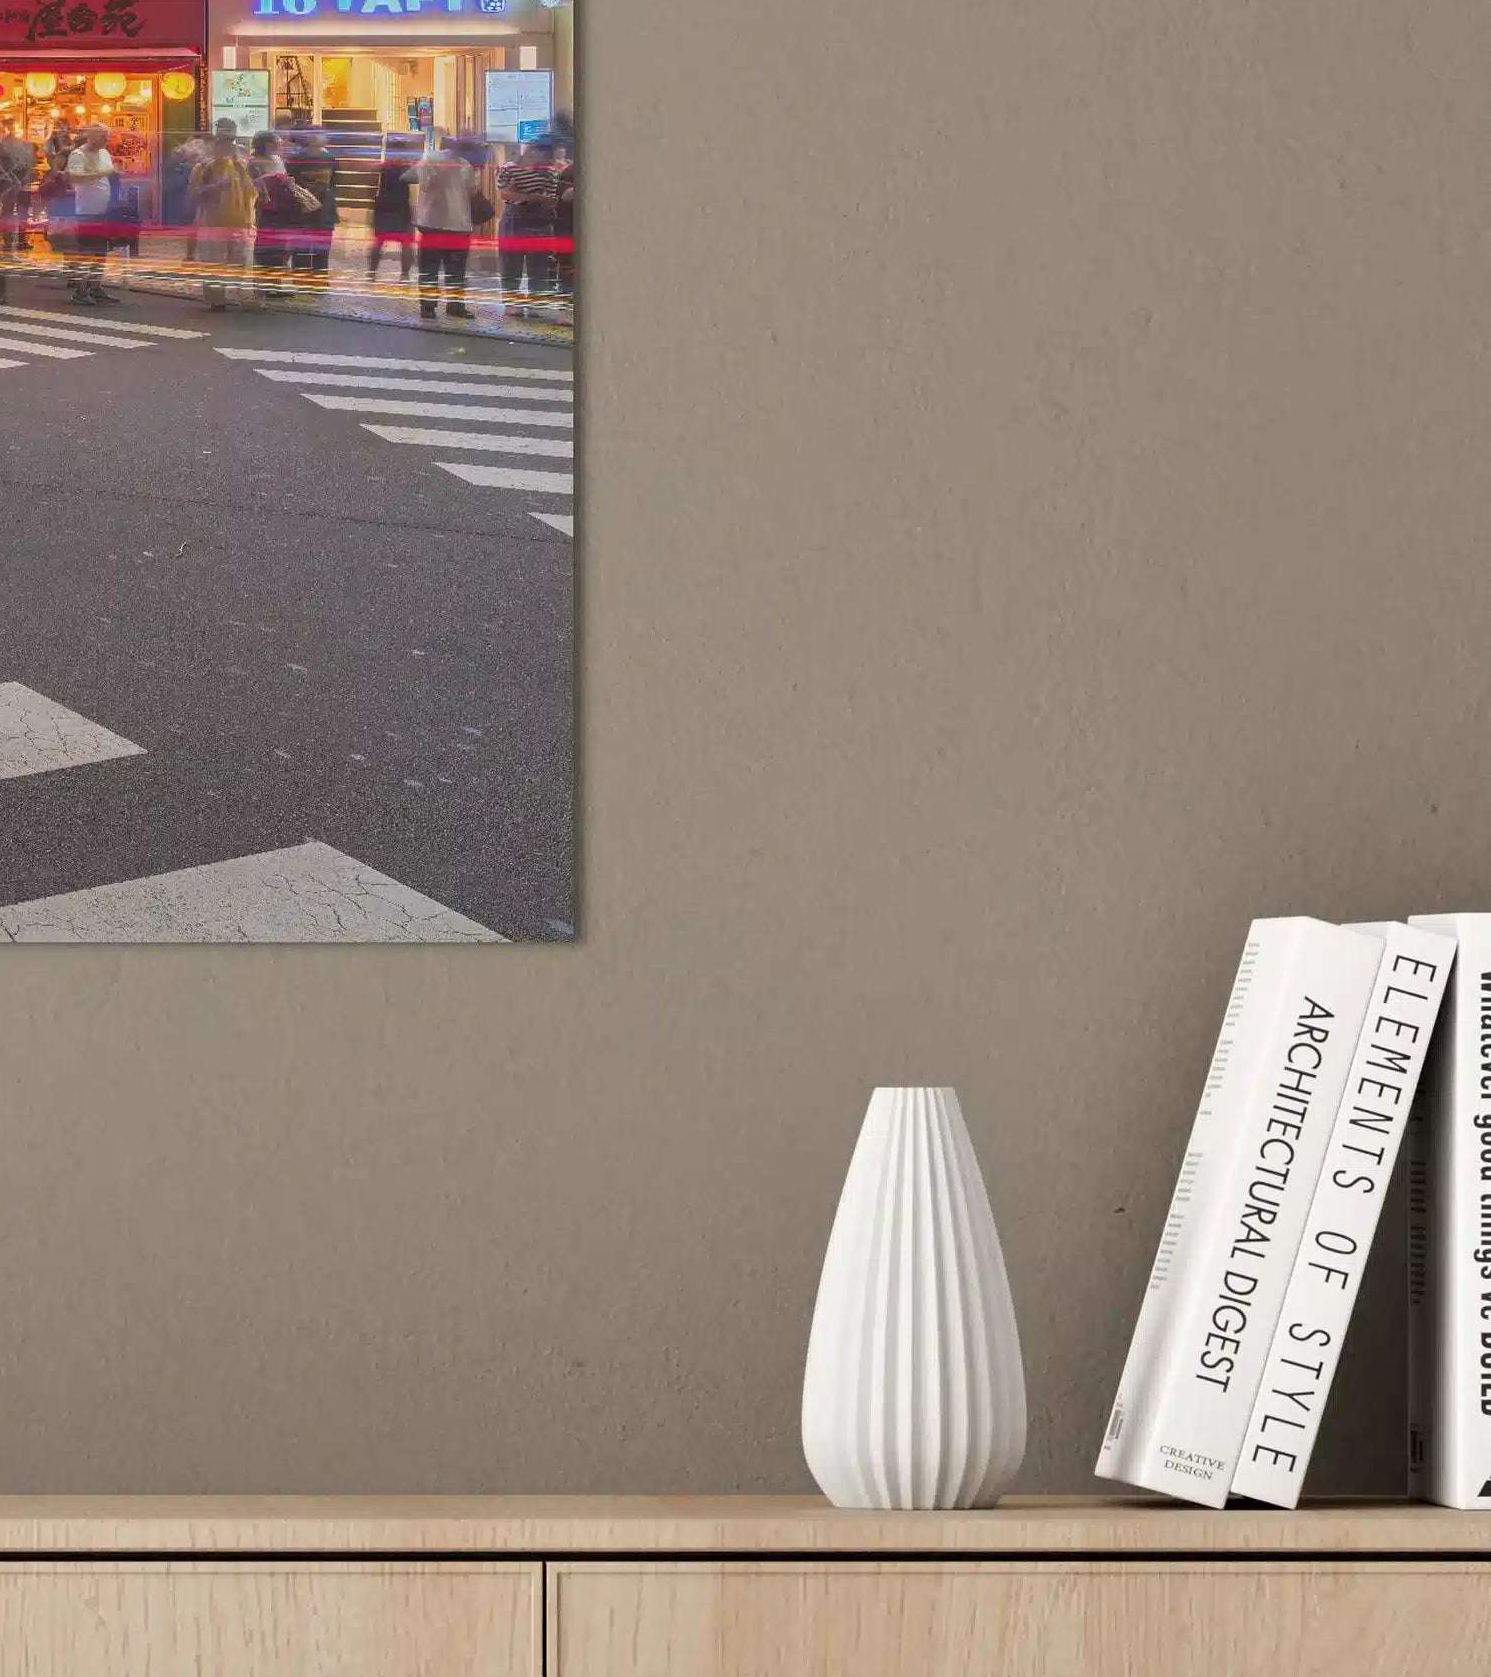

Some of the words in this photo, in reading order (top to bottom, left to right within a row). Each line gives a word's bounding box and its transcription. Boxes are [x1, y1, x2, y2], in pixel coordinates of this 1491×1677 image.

[1230, 995, 1335, 1265] ARCHITECTURAL
[1332, 954, 1437, 1195] ELEMENTS
[1308, 1230, 1358, 1291] OF
[1195, 1272, 1259, 1393] DIGEST
[1159, 1445, 1226, 1471] CREATIVE
[1252, 1321, 1332, 1474] STYLE
[1164, 1459, 1214, 1480] DESIGN
